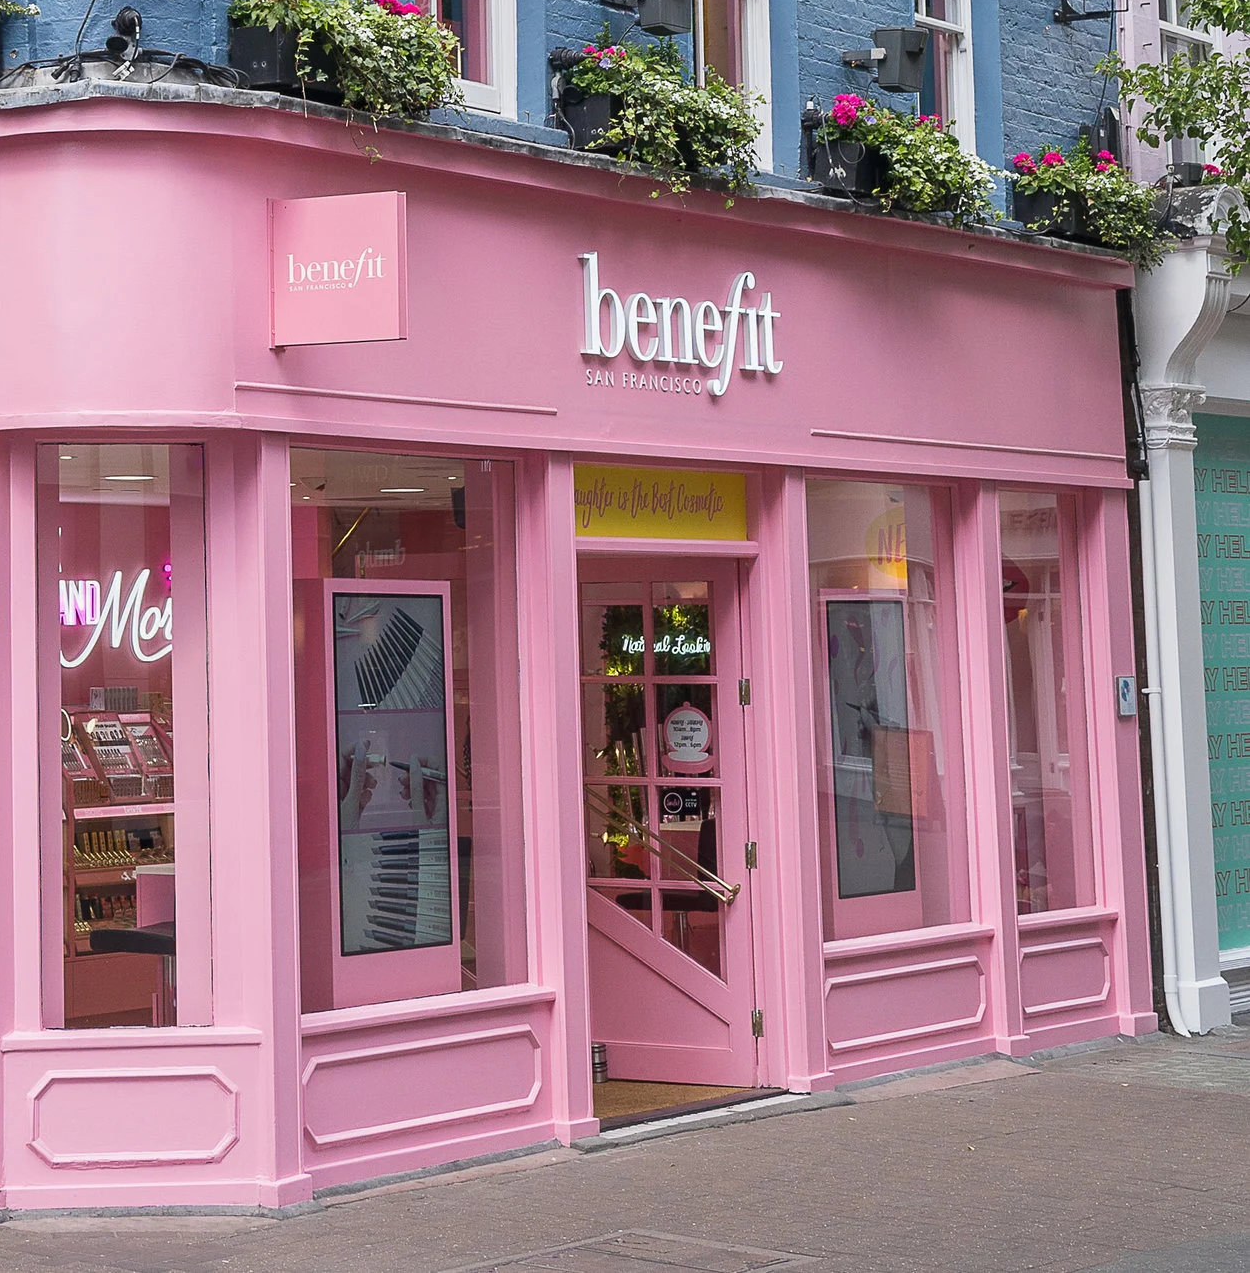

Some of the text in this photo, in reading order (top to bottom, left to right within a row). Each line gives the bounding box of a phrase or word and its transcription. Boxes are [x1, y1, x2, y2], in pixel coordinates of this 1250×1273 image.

[286, 247, 386, 288] benefit
[289, 284, 303, 292] SAN
[577, 251, 784, 396] benefit
[586, 369, 701, 395] SAN FRANCISCO
[574, 477, 724, 528] aughter is the Best Cosmetic
[878, 523, 906, 565] NE
[60, 569, 173, 668] Mor
[671, 634, 710, 654] Lookin
